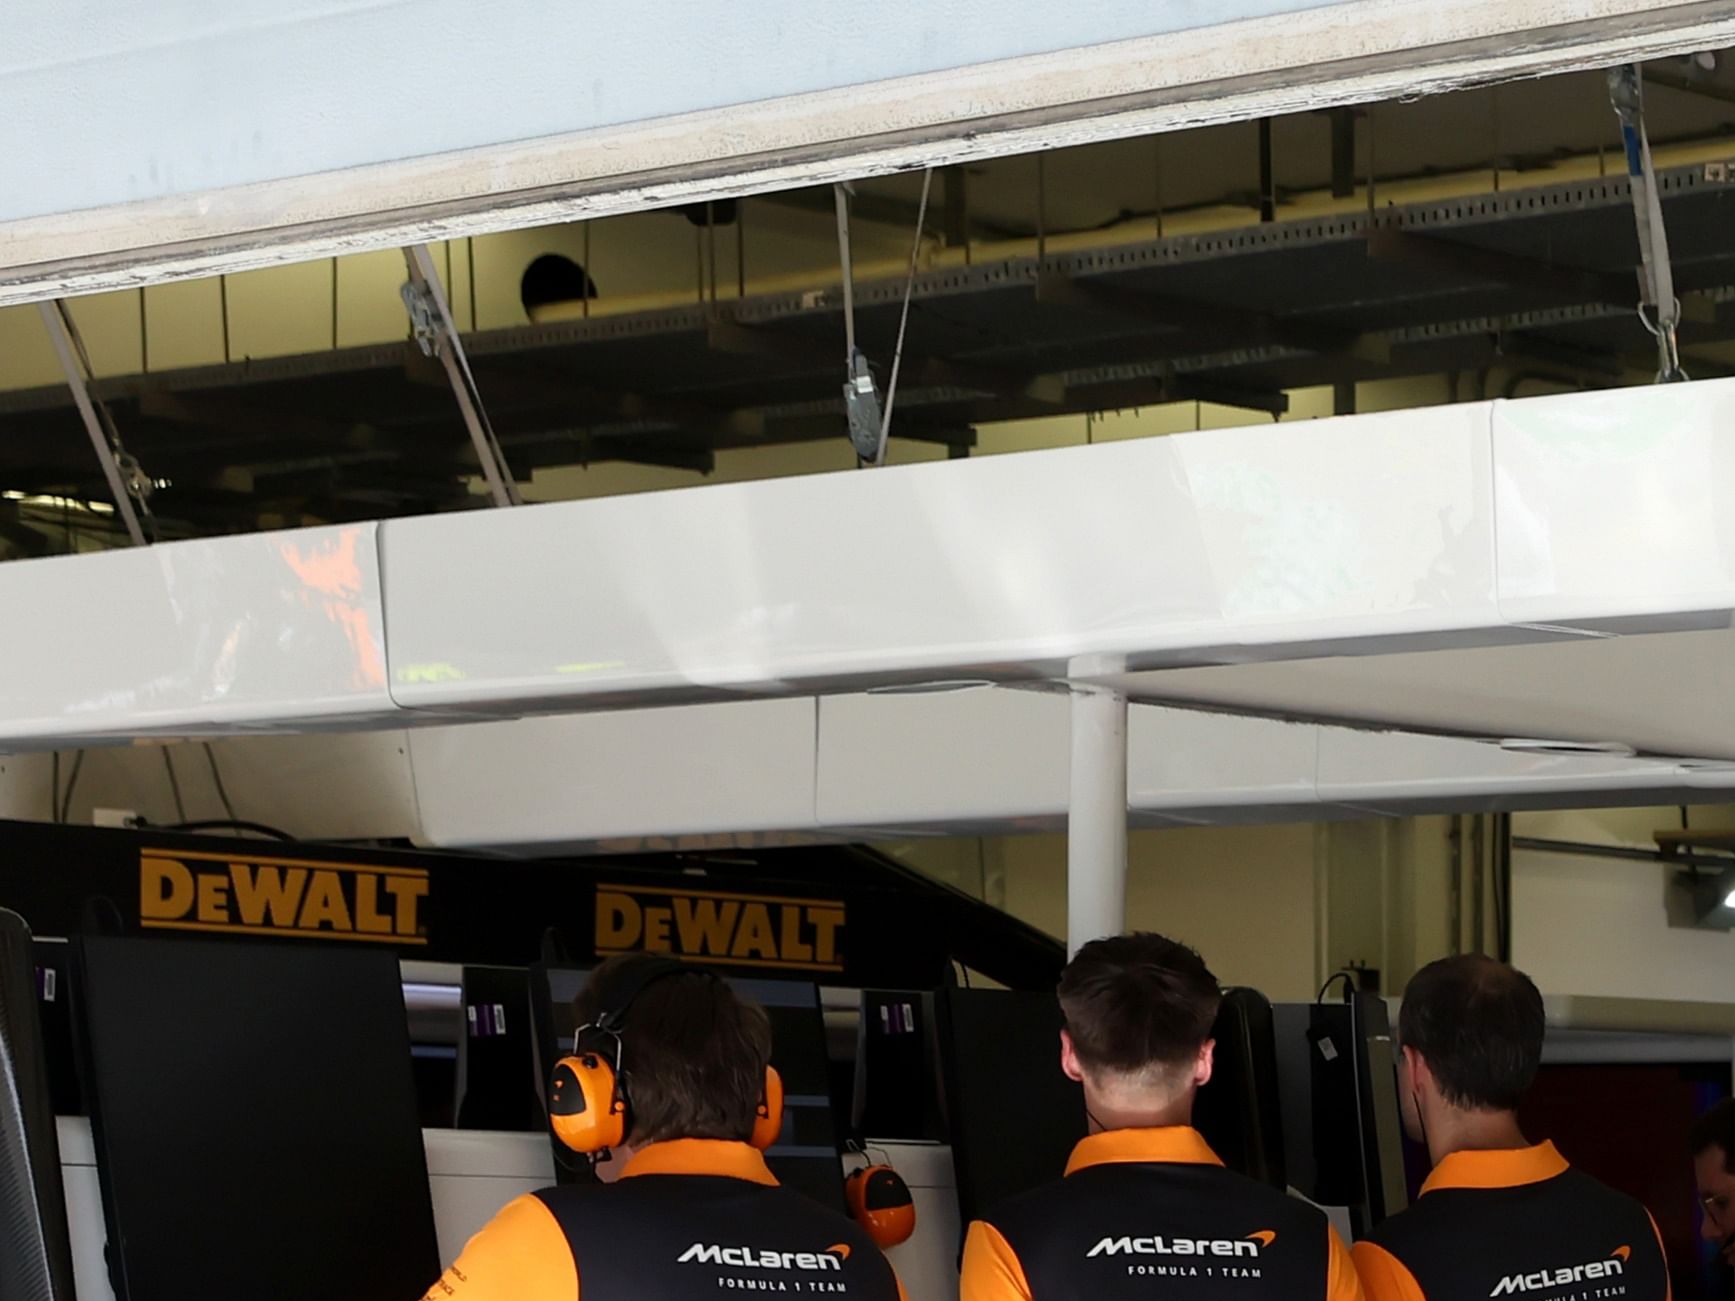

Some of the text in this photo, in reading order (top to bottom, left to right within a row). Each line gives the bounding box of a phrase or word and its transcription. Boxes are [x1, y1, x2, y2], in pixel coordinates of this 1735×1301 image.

[1087, 1235, 1259, 1258] McLaren
[677, 1244, 841, 1270] McLaren
[1128, 1265, 1197, 1277] FORMULA
[1222, 1267, 1262, 1279] TEAM
[1490, 1259, 1623, 1297] McLaren
[719, 1277, 786, 1291] FORMULA
[810, 1282, 846, 1292] TEAM
[1595, 1285, 1627, 1301] TEAM
